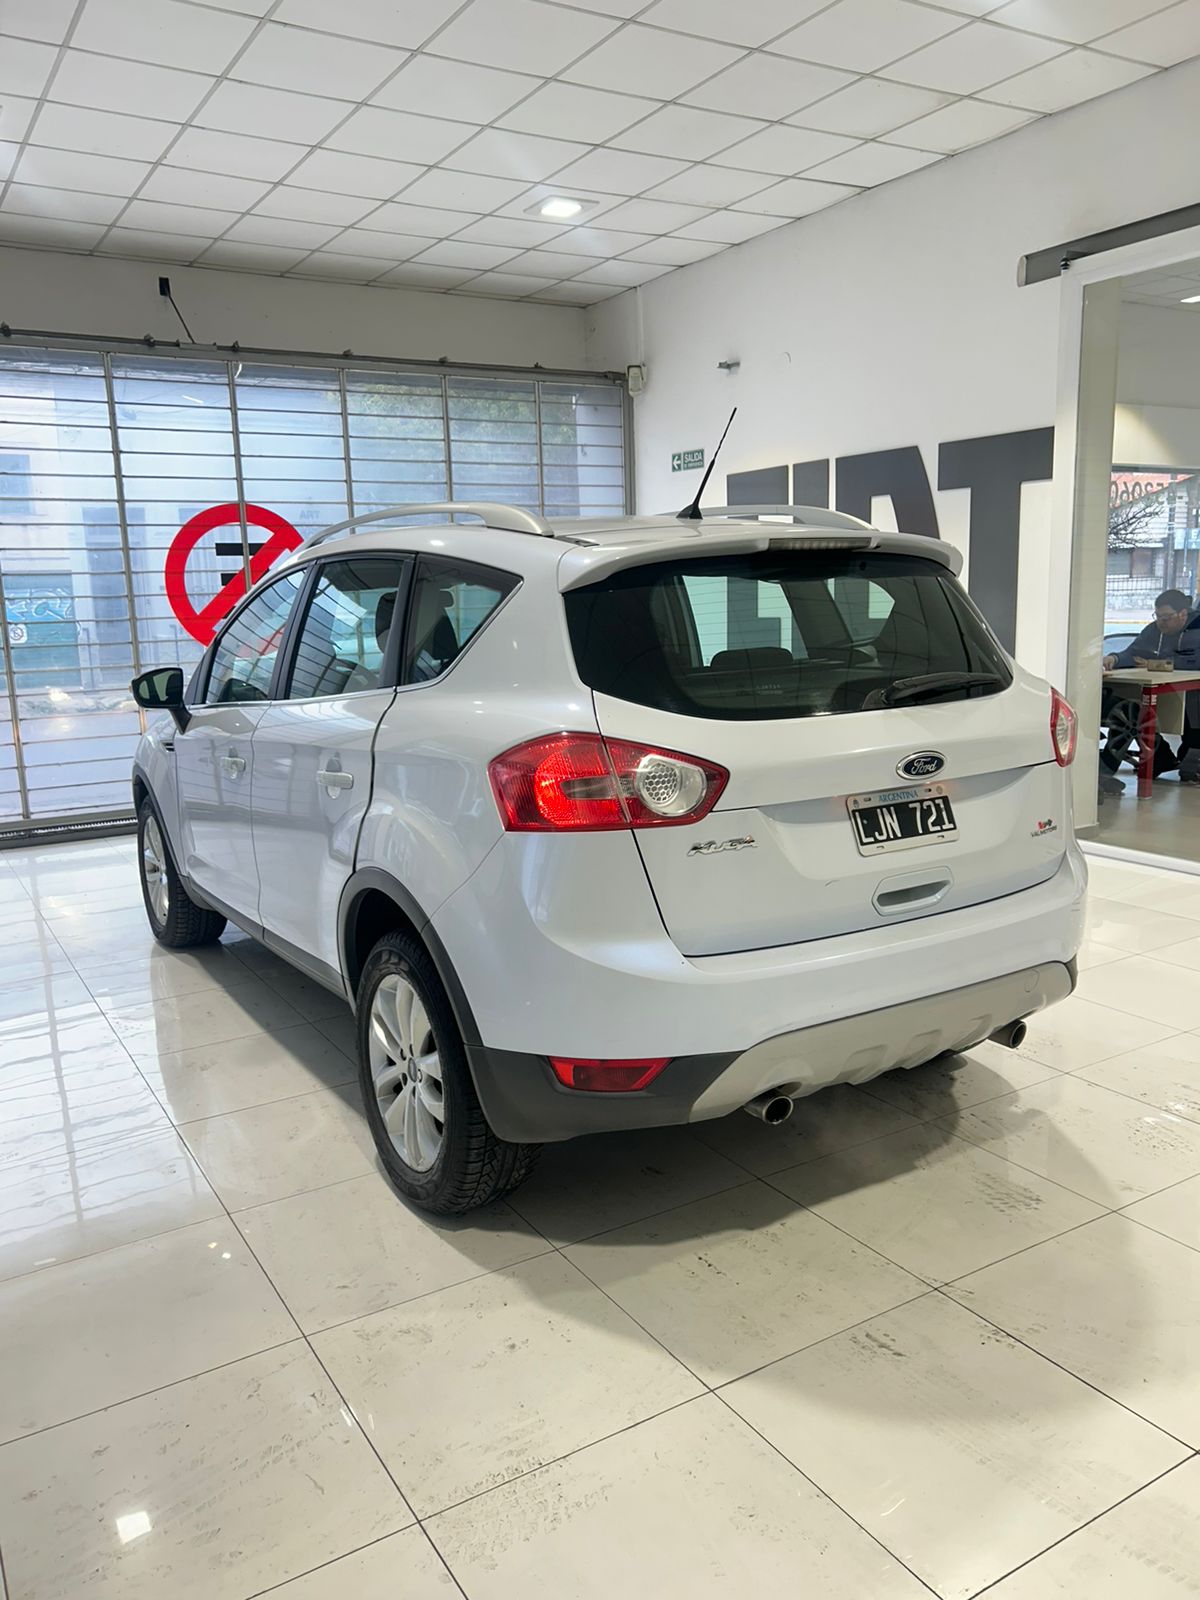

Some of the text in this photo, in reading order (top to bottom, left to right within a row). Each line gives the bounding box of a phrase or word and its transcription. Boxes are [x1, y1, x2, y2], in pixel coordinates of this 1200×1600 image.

[684, 451, 703, 462] SALIDA
[910, 757, 938, 775] Ford
[878, 789, 920, 803] ARGENTINA
[855, 798, 955, 843] LJN 721
